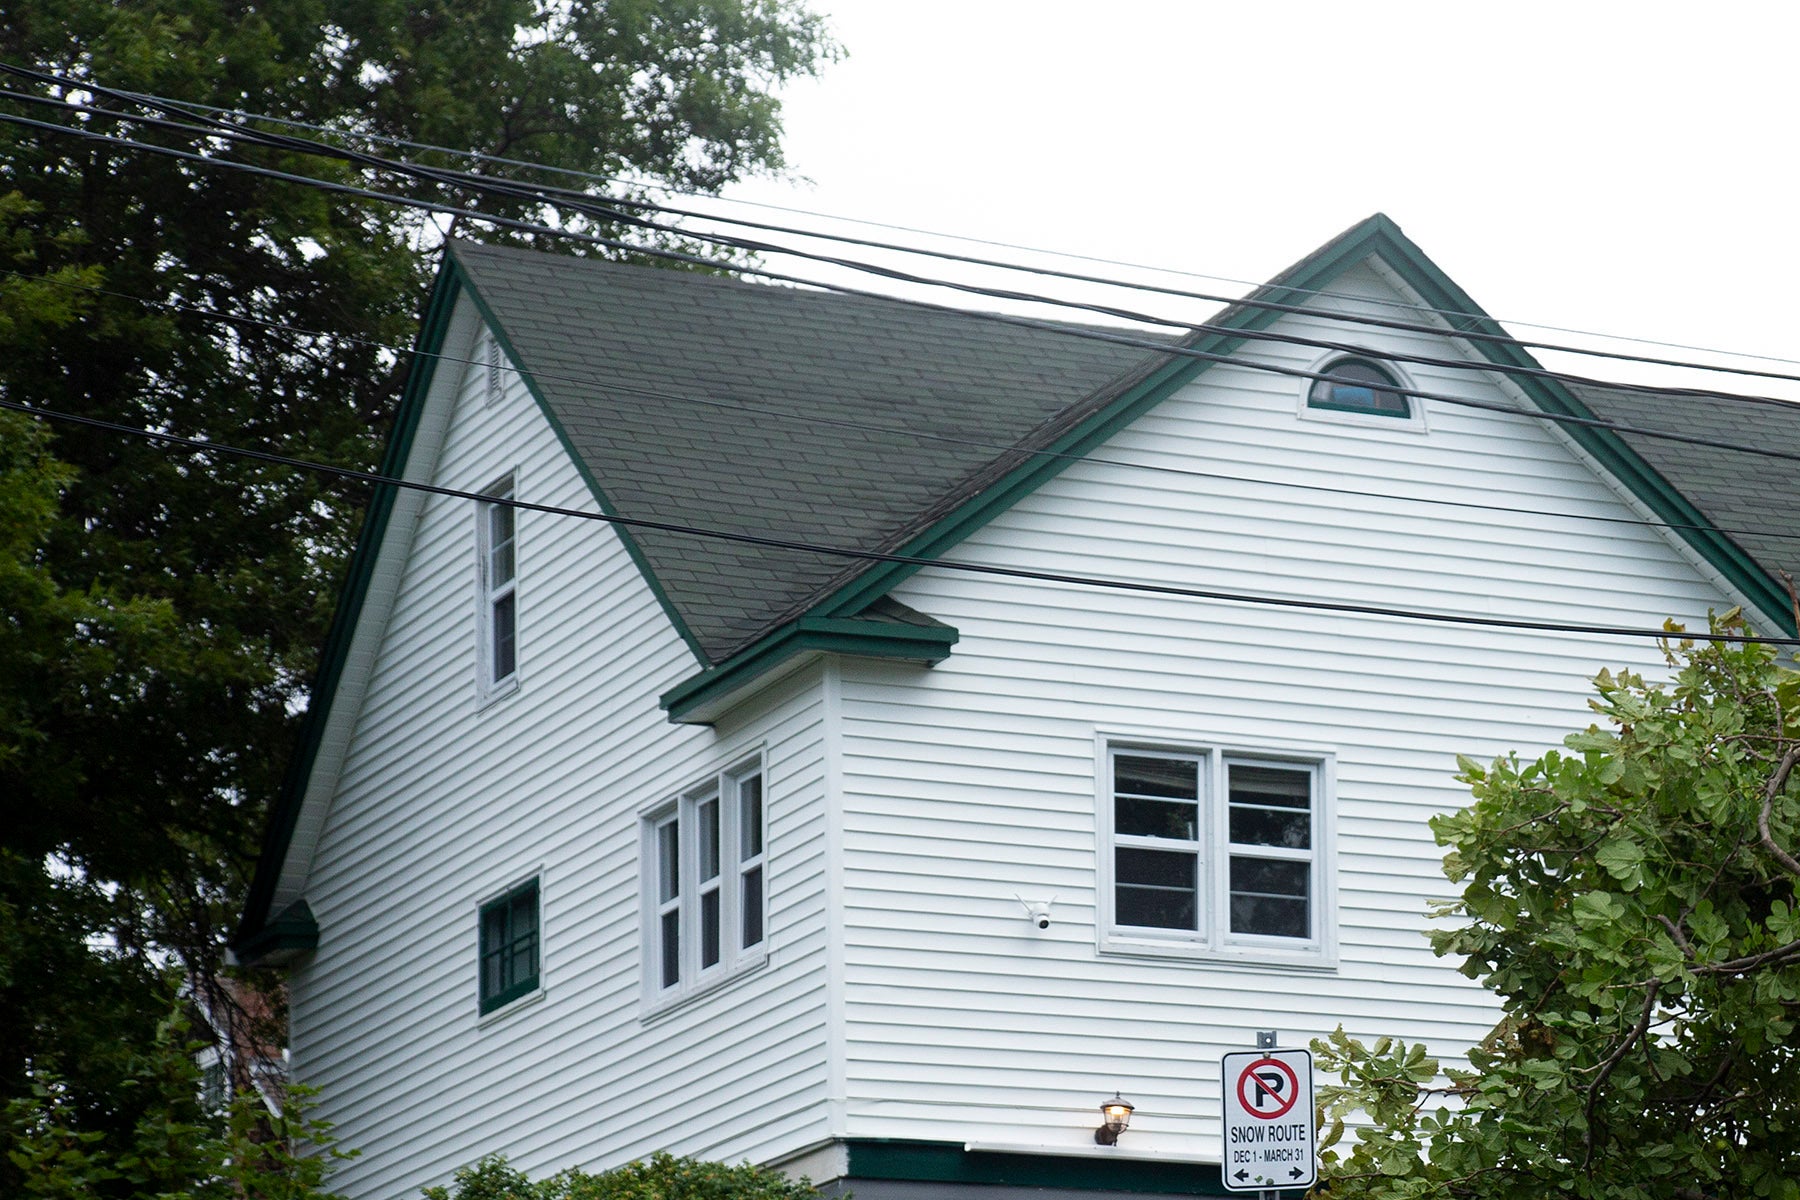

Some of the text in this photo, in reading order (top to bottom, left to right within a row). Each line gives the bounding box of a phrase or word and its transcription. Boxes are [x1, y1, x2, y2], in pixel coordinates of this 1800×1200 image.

[1231, 1125, 1305, 1143] SNOW ROUTE
[1234, 1150, 1250, 1163] DEC
[1253, 1151, 1257, 1162] 1
[1264, 1148, 1293, 1162] MARCH
[1295, 1148, 1304, 1161] 31
